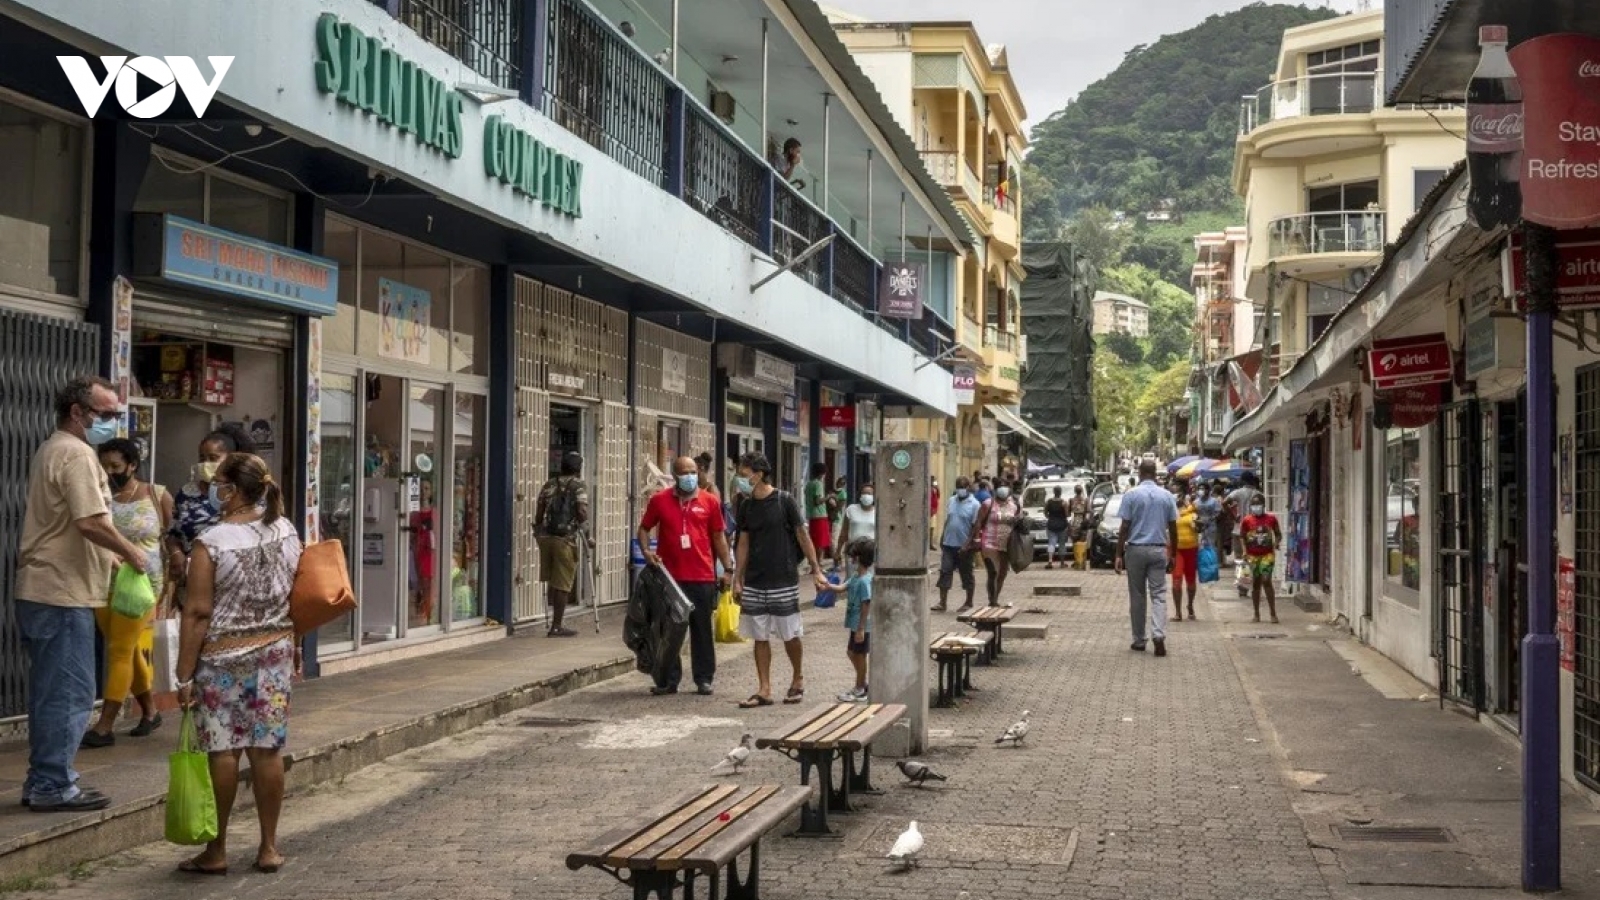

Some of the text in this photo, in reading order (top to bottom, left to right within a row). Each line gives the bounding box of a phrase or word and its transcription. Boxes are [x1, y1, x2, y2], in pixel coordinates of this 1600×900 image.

[315, 12, 583, 218] SRINIVAS COMPLEX
[1528, 158, 1600, 179] Refres
[181, 229, 213, 263] SRI
[1565, 257, 1600, 276] airt
[1400, 353, 1430, 367] airtel
